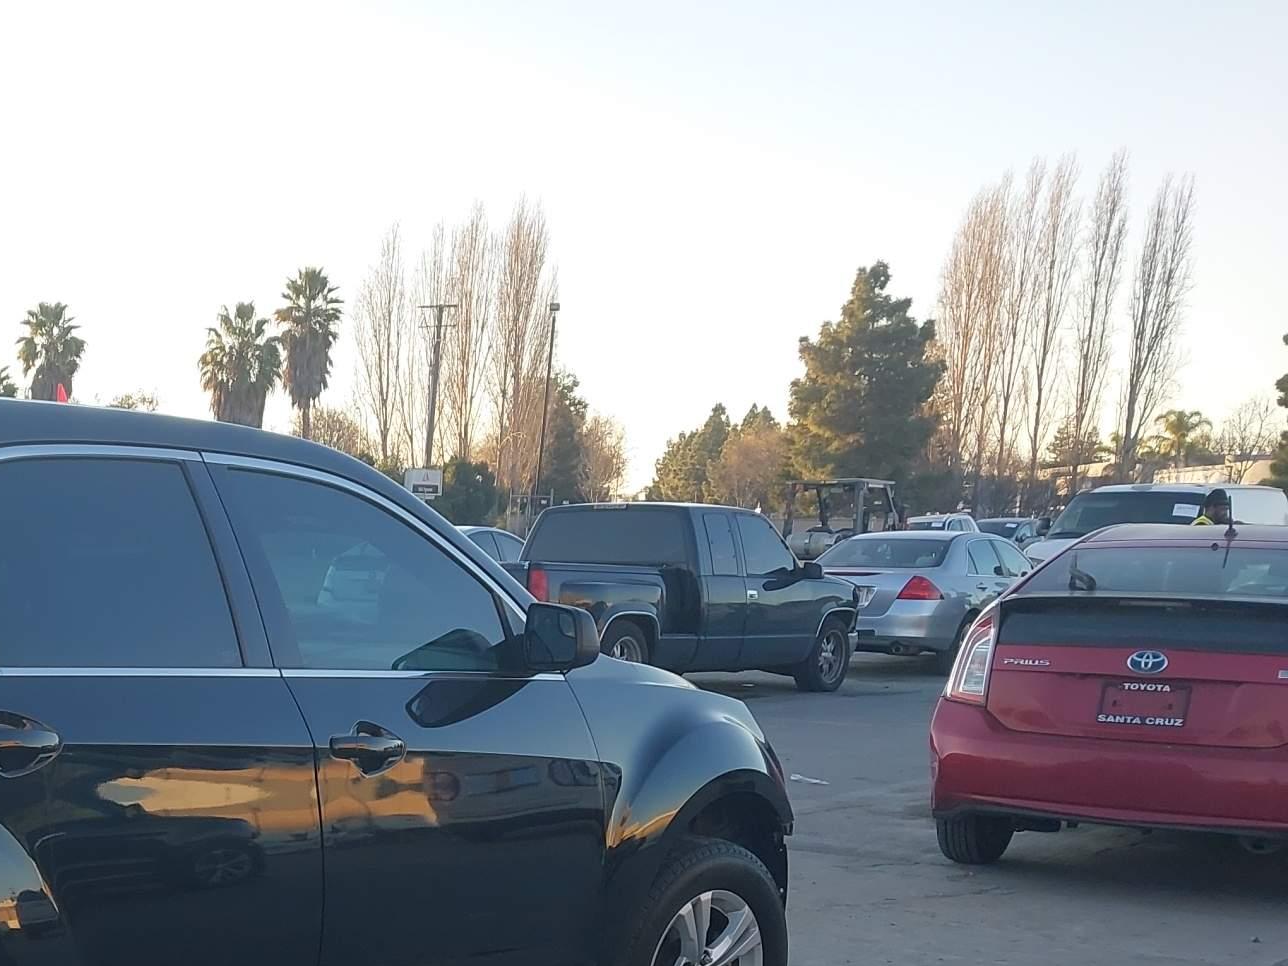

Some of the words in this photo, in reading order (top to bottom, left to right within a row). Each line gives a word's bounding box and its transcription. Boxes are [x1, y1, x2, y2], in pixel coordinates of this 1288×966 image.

[1003, 658, 1050, 666] PRIUS
[1123, 682, 1171, 692] TOYOTA
[1097, 714, 1141, 724] SANTA
[1145, 717, 1184, 727] CRUZ
